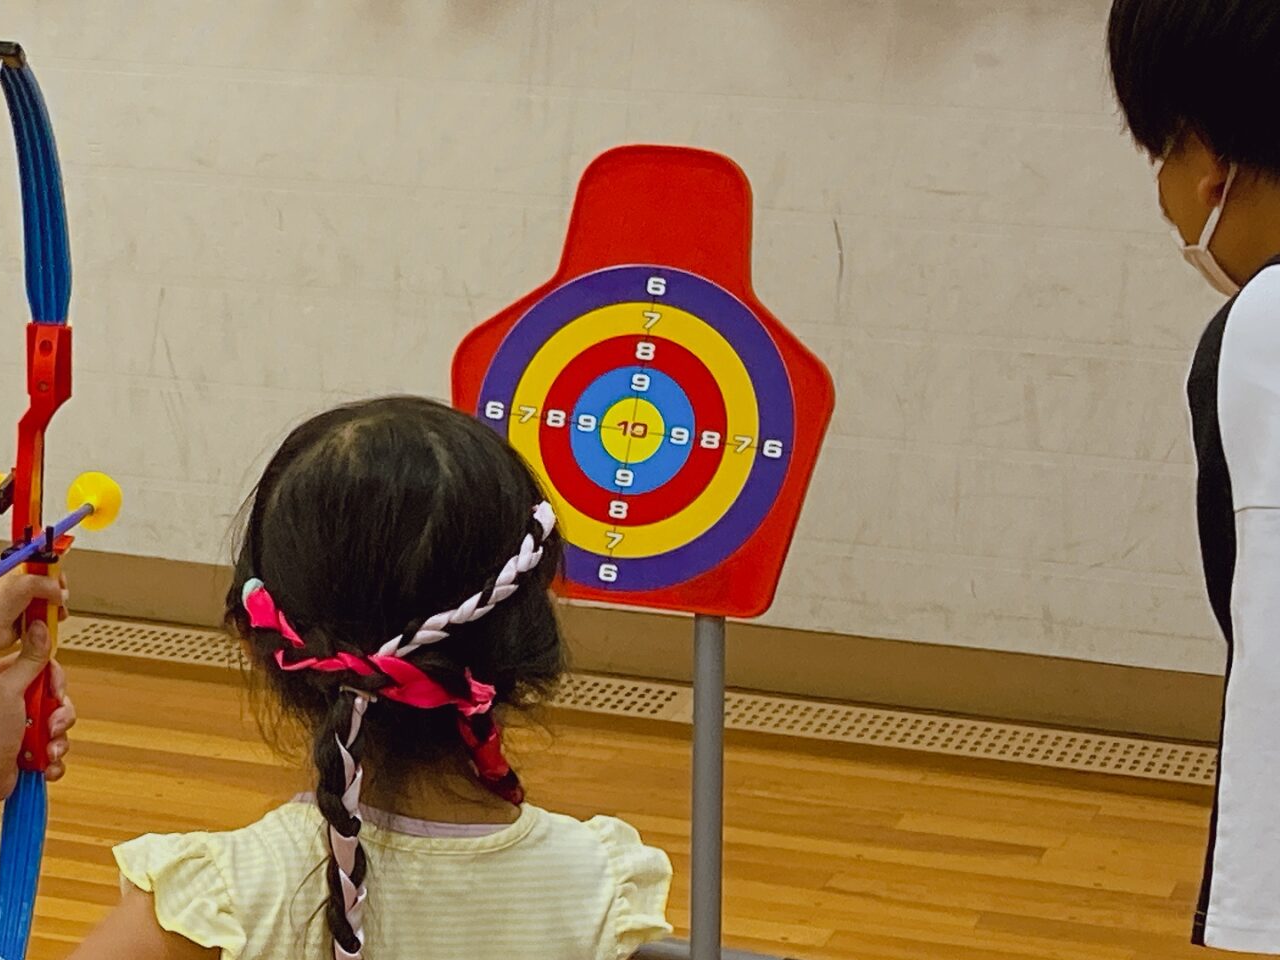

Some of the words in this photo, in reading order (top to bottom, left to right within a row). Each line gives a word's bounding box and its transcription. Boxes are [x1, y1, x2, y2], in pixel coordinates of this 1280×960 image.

[647, 276, 666, 296] 6
[642, 311, 661, 329] 7
[635, 341, 656, 361] 8
[631, 373, 651, 393] 9
[485, 401, 505, 420] 6
[519, 406, 538, 424] 7
[545, 409, 567, 428] 8
[577, 414, 597, 433] 9
[617, 420, 648, 438] 10
[670, 427, 690, 446] 9
[700, 430, 721, 450] 8
[734, 435, 754, 454] 7
[763, 439, 783, 458] 6
[614, 468, 635, 488] 9
[609, 500, 628, 519] 8
[605, 531, 623, 549] 7
[598, 563, 618, 582] 6
